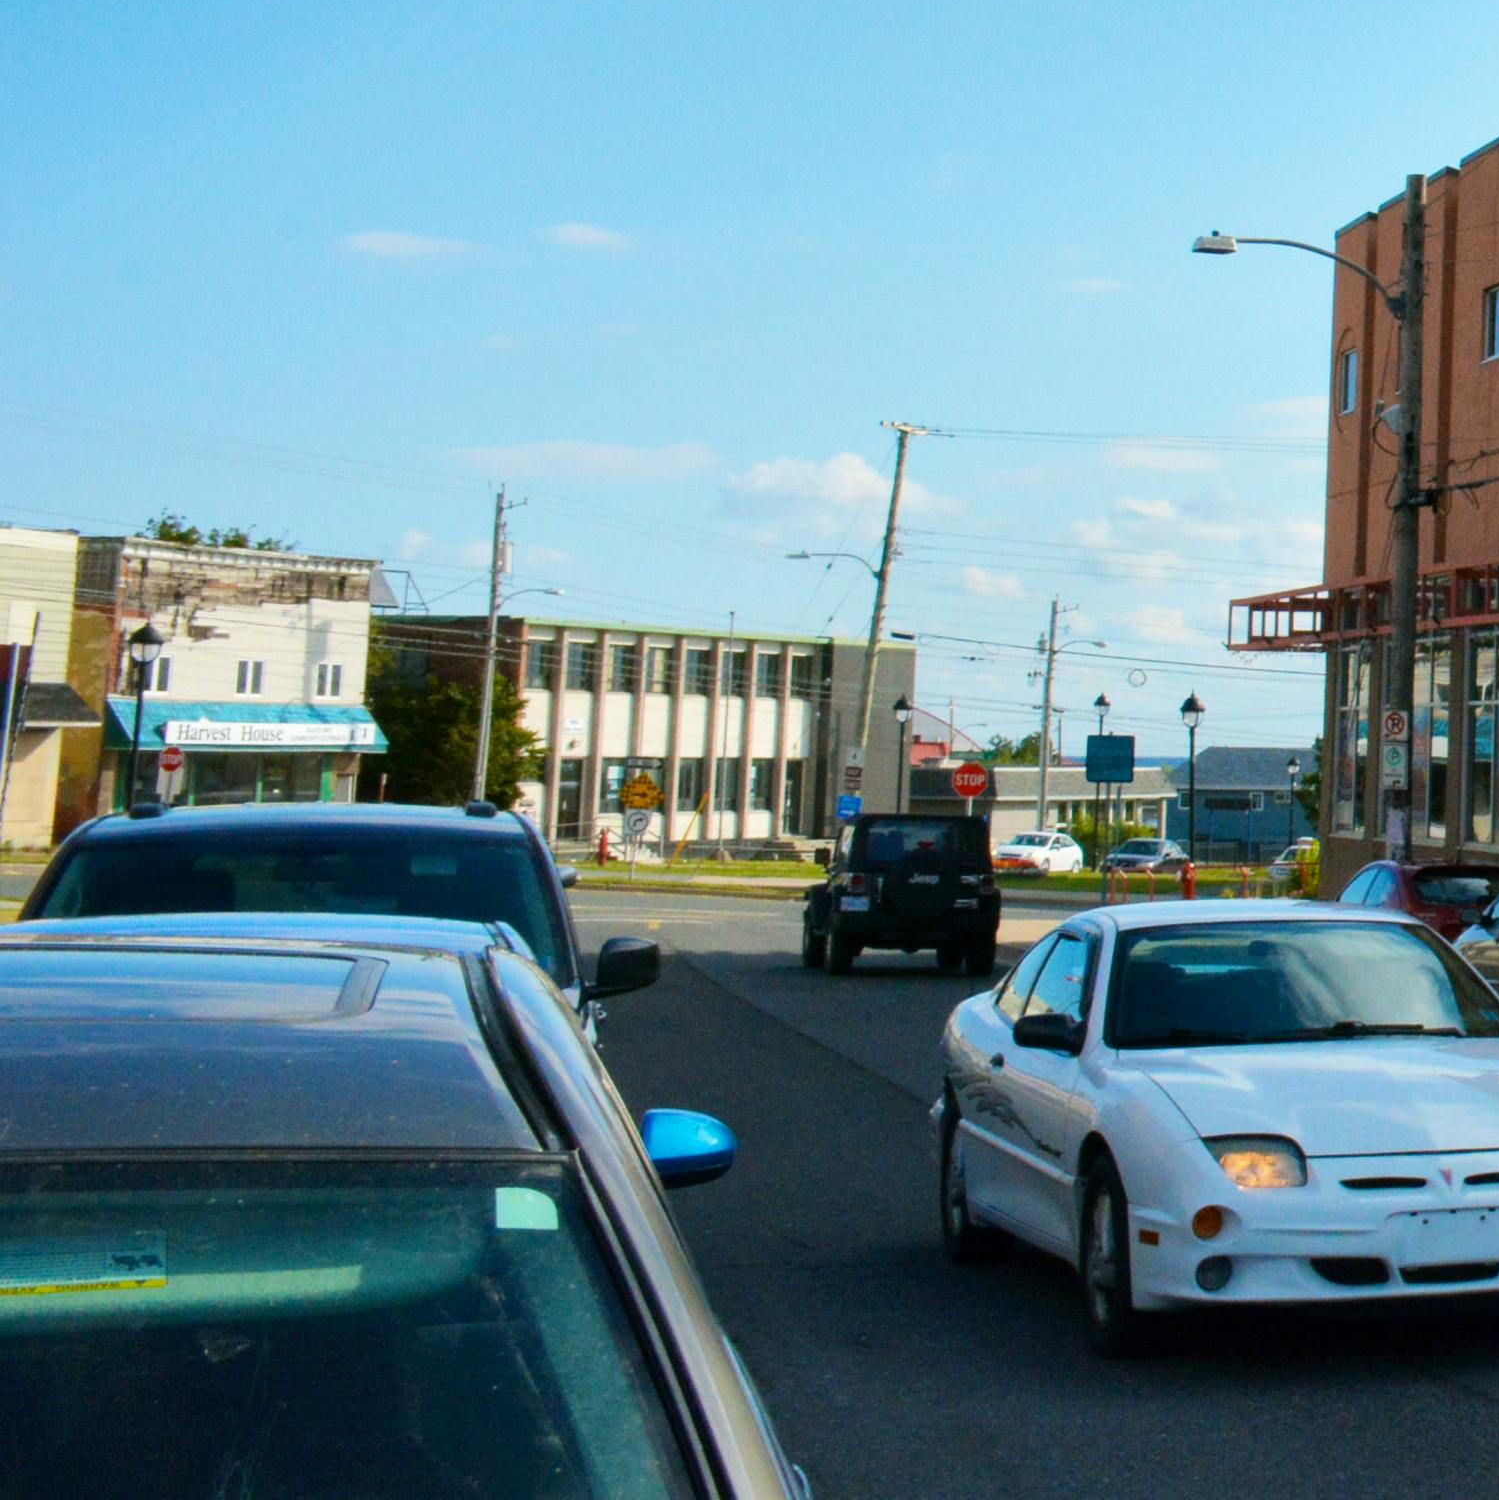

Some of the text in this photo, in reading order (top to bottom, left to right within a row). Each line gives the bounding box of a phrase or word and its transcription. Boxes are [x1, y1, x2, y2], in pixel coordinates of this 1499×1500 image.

[177, 723, 284, 741] Harvest House
[955, 773, 986, 787] STOP
